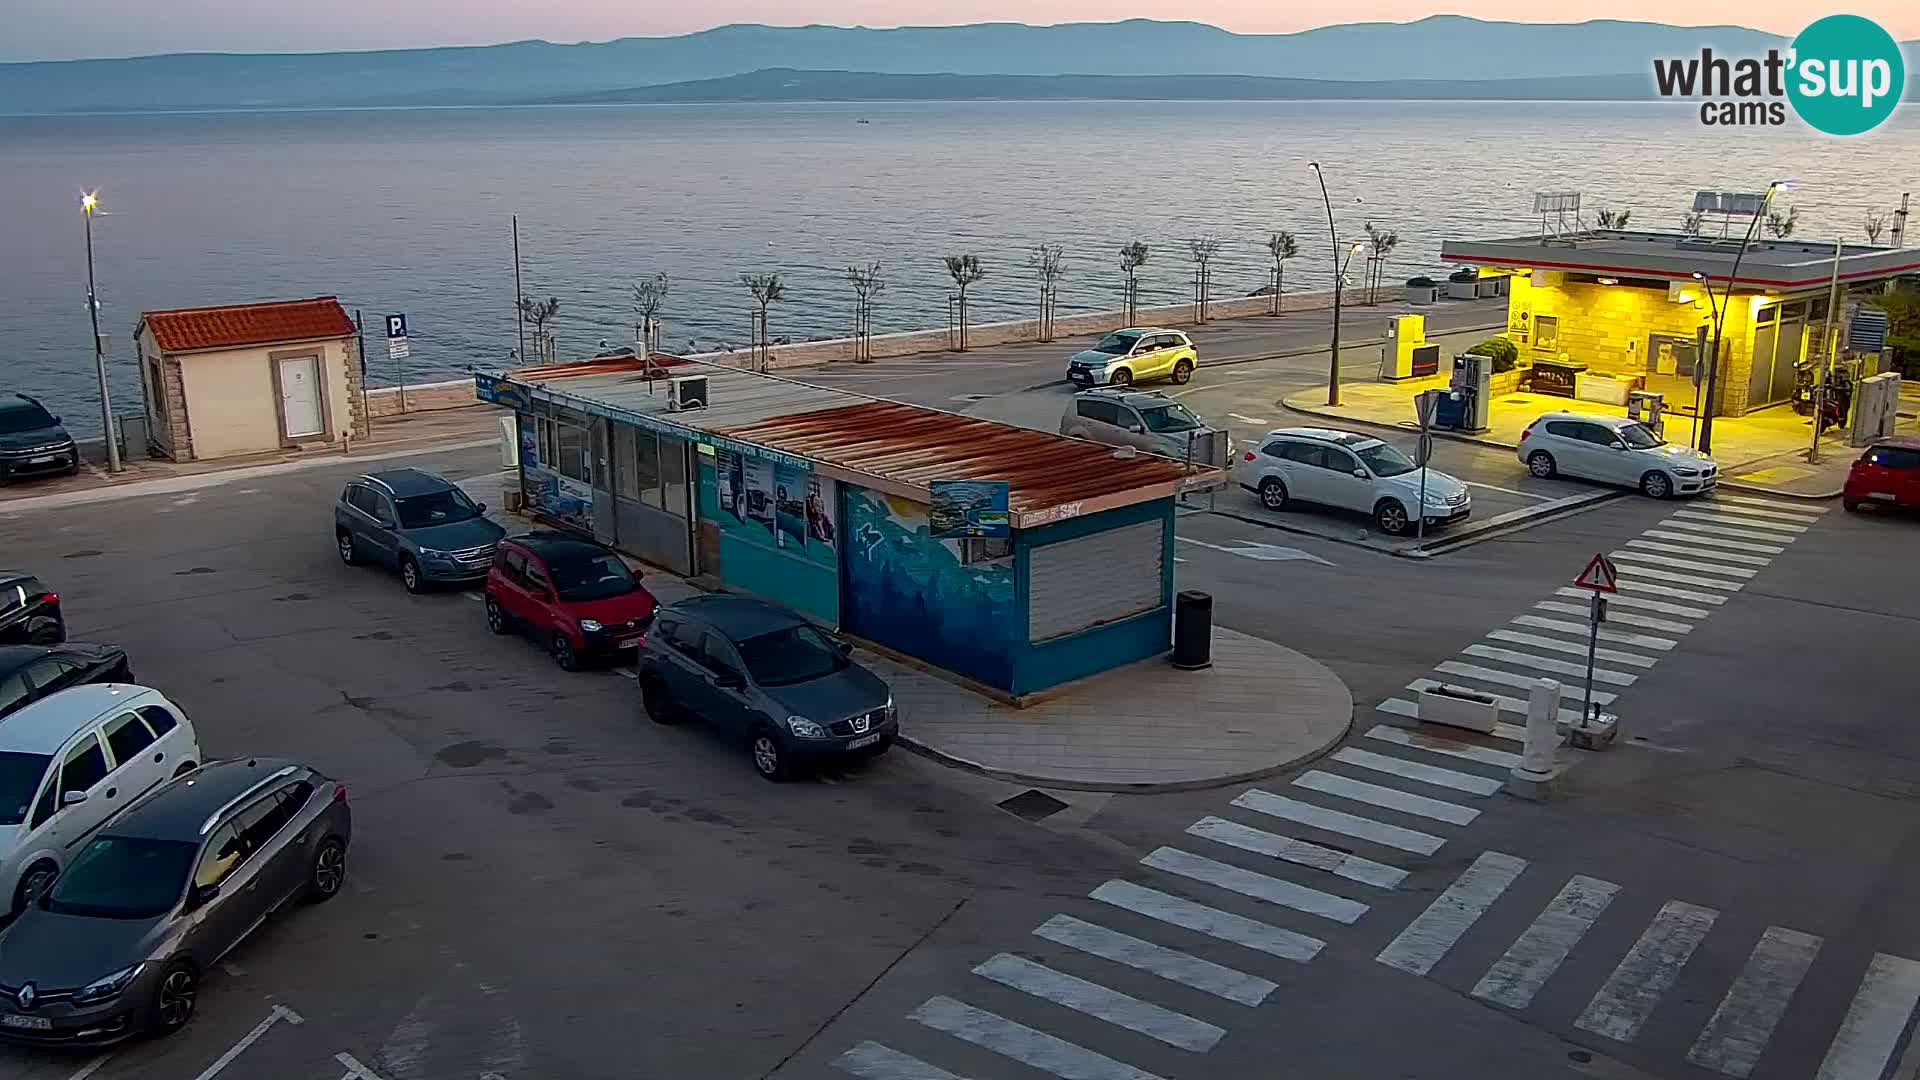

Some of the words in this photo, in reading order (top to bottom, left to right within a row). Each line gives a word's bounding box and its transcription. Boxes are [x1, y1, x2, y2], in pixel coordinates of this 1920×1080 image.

[390, 317, 402, 335] P
[726, 441, 756, 456] STATION
[759, 450, 783, 463] TICKET
[784, 456, 810, 470] OFFICE
